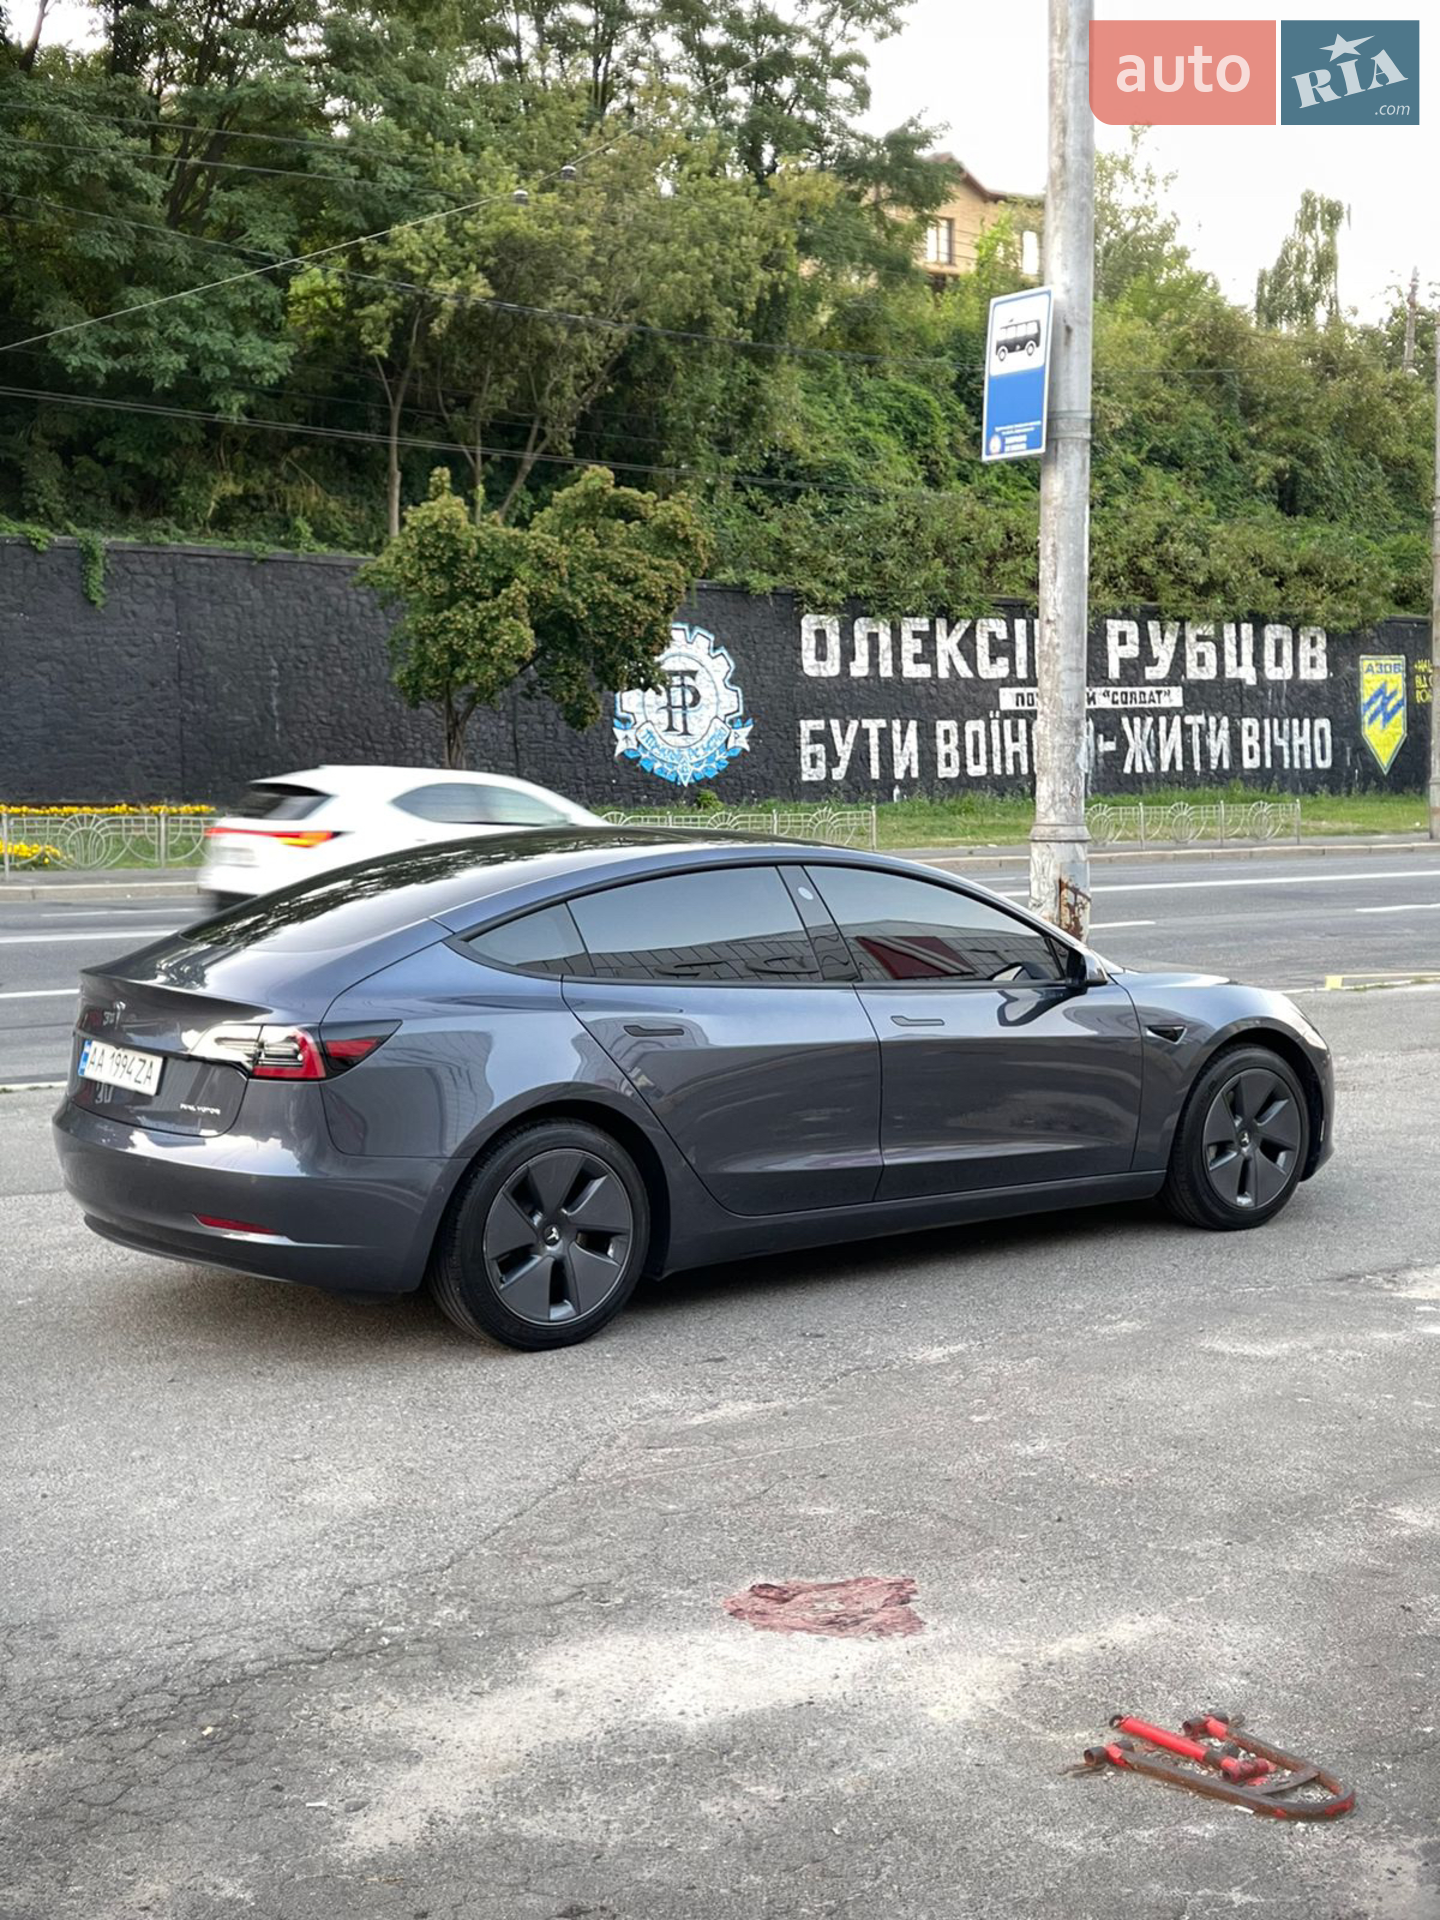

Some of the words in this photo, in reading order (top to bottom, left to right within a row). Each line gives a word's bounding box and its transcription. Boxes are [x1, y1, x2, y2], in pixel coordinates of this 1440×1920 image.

[801, 614, 1037, 679] ОЛЕКСІ
[1106, 619, 1329, 685] РУБЦОВ
[800, 718, 919, 781] БУТИ
[1241, 718, 1332, 770] ВІЧНО
